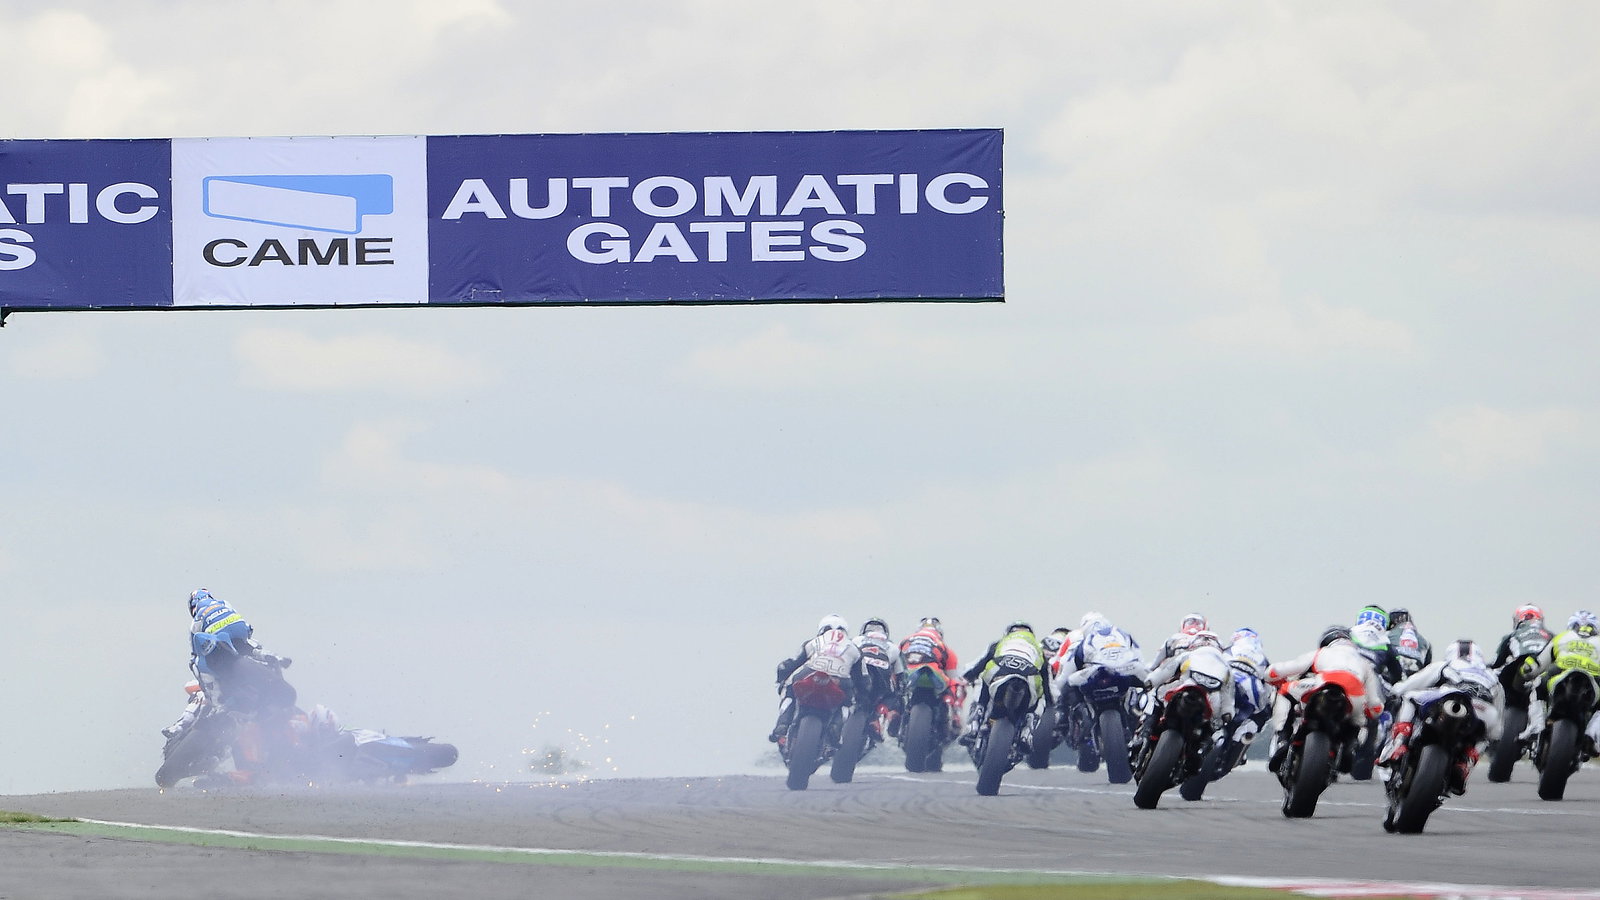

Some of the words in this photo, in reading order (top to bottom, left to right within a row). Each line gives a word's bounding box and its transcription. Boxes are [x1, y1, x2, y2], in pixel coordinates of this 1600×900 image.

[0, 182, 159, 225] TIC
[441, 172, 989, 221] AUTOMATIC
[203, 237, 394, 268] CAME
[566, 220, 867, 264] GATES
[830, 630, 845, 643] 19
[999, 655, 1033, 672] RST
